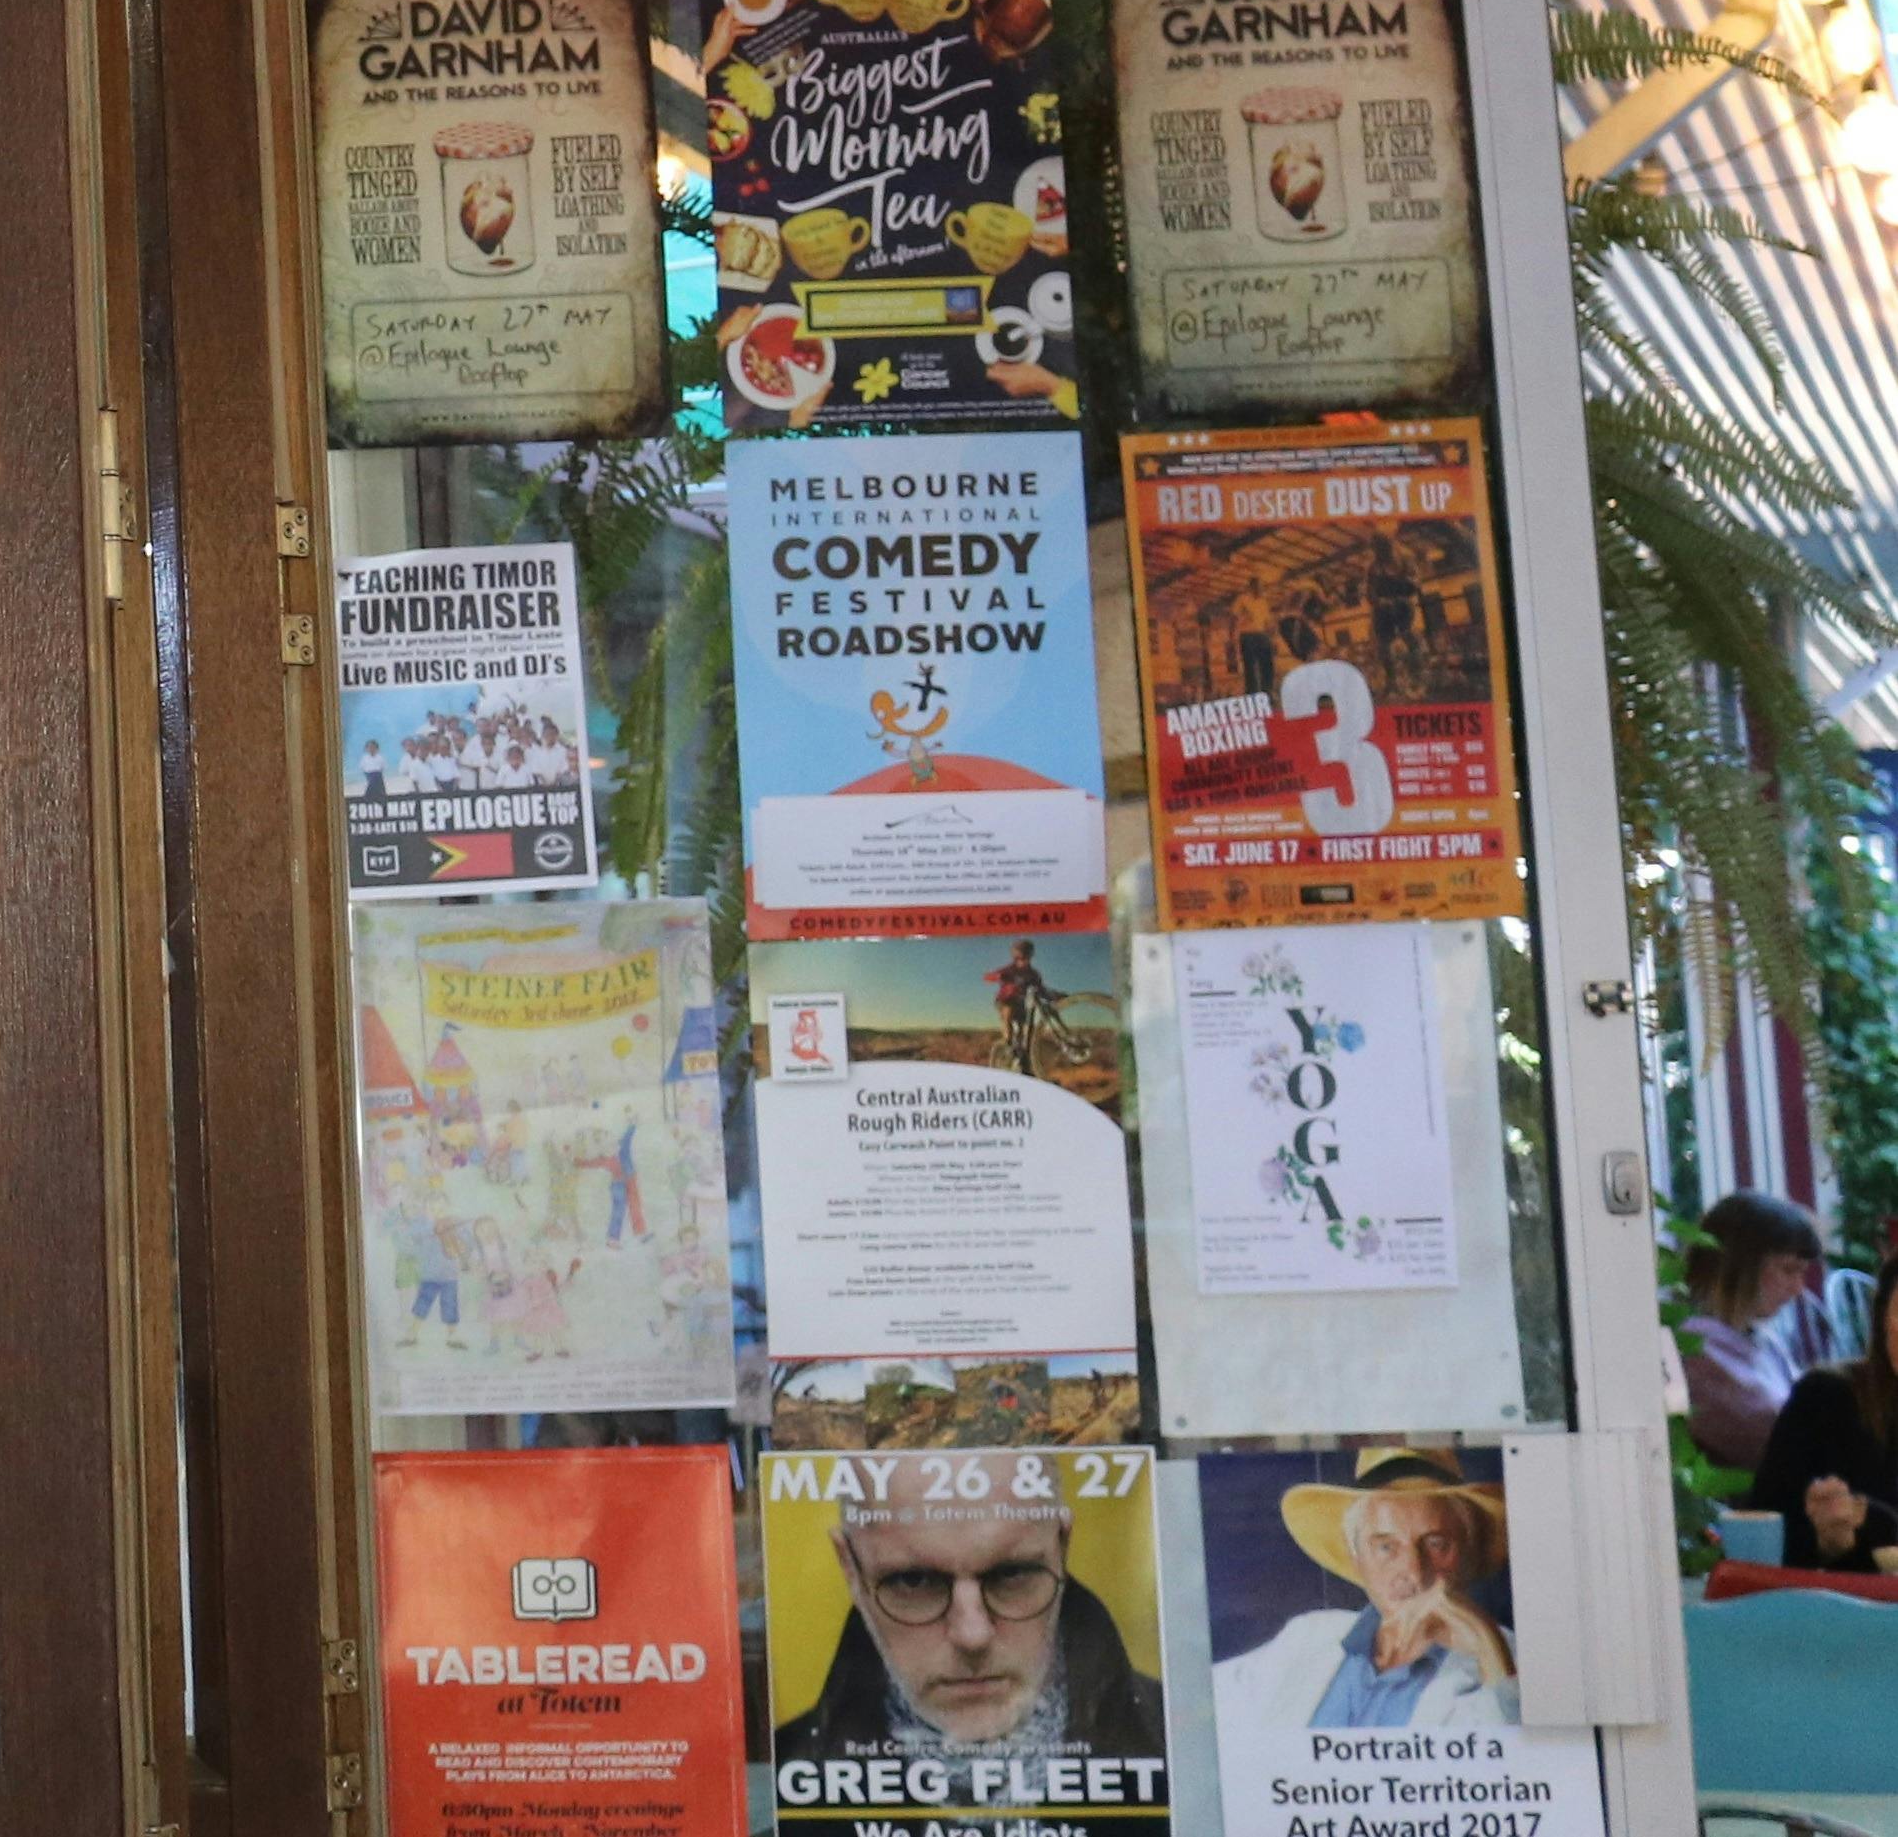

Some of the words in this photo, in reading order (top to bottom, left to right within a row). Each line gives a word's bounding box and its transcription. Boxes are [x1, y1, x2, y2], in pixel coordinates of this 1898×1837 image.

[1161, 0, 1409, 48] GARNHAM
[358, 36, 602, 82] GARNHAM
[362, 88, 400, 106] AND
[407, 86, 438, 102] THE
[445, 82, 528, 101] REASONS
[535, 80, 561, 96] TO
[567, 79, 603, 95] LIVE
[785, 34, 971, 129] Biggest
[344, 143, 416, 171] COUNTRY
[550, 133, 623, 165] FUELED
[770, 102, 994, 185] Morning
[346, 168, 418, 199] TINGED
[777, 166, 952, 248] Tea
[351, 234, 423, 265] WOMEN
[769, 471, 1039, 503] MELBOURNE
[1156, 483, 1224, 526] RED
[1232, 486, 1315, 522] DESERT
[1324, 473, 1413, 516] DUST
[1419, 480, 1454, 514] UP
[771, 506, 1041, 528] INTERNATIONAL
[772, 531, 1042, 581] COMEDY
[338, 563, 466, 595] TEACHING
[472, 559, 557, 589] TIMOR
[340, 591, 561, 636] FUNDRAISER
[775, 587, 1045, 616] FESTIVAL
[777, 620, 1047, 659] ROADSHOW
[342, 663, 387, 687] Live
[394, 658, 468, 685] MUSIC
[474, 655, 518, 680] and
[523, 652, 568, 676] DJ's
[1165, 689, 1274, 737] AMATEUR
[1391, 710, 1484, 741] TICKETS
[1178, 719, 1270, 762] BOXING
[1279, 657, 1396, 836] 3
[386, 800, 418, 819] MAY
[419, 792, 548, 833] EPILOGUE
[548, 804, 580, 827] TOP
[1182, 841, 1222, 867] SAT.
[1223, 839, 1276, 866] JUNE
[1277, 838, 1300, 864] 17
[1320, 835, 1374, 863] FIRST
[1379, 834, 1433, 861] FIGHT
[1437, 832, 1483, 859] 5PM
[855, 1086, 923, 1108] Central
[927, 1084, 1022, 1106] Australian
[847, 1111, 907, 1136] Rough
[911, 1109, 969, 1132] Riders
[971, 1107, 1034, 1132] (CARR)
[769, 1456, 899, 1503] MAY
[919, 1455, 991, 1501] 26
[1010, 1454, 1054, 1500] &
[1073, 1452, 1147, 1500] 27
[992, 1503, 1072, 1522] Theatre
[406, 1642, 708, 1687] TABLEREAD
[497, 1694, 525, 1716] at
[529, 1686, 622, 1716] Totem
[844, 1739, 880, 1757] Red
[1311, 1734, 1435, 1764] Portrait
[1444, 1731, 1478, 1760] of
[1487, 1738, 1505, 1760] a
[776, 1759, 951, 1807] GREG
[971, 1756, 1166, 1805] FLEET
[1270, 1776, 1375, 1807] Senior
[1380, 1774, 1552, 1804] Territorian
[1285, 1814, 1338, 1837] Art
[1344, 1813, 1452, 1837] Award
[1460, 1812, 1543, 1837] 2017
